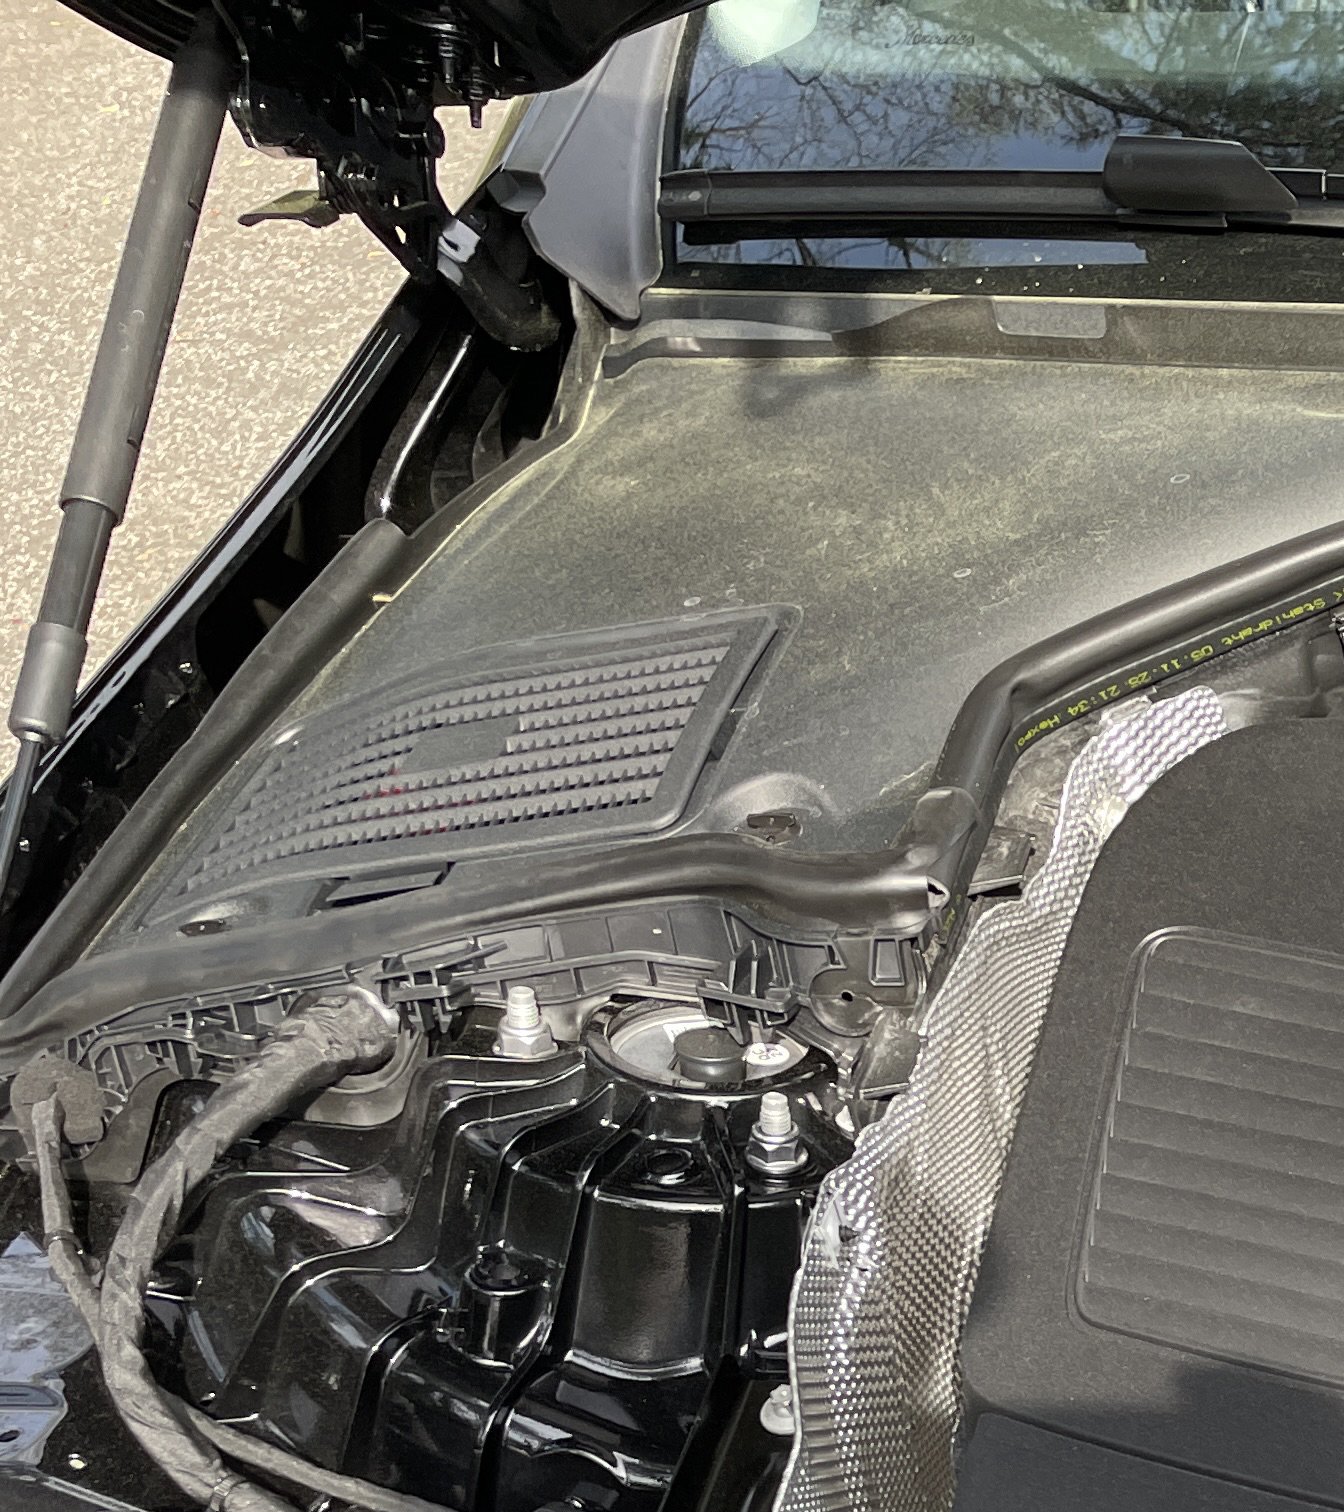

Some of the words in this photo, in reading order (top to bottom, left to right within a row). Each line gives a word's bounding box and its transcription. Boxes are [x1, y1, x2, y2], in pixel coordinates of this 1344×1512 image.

[1220, 598, 1328, 645] Stahldraht
[1125, 644, 1214, 689] 05.11.25
[1067, 683, 1121, 717] 21:34
[1013, 714, 1063, 754] Hexpol
